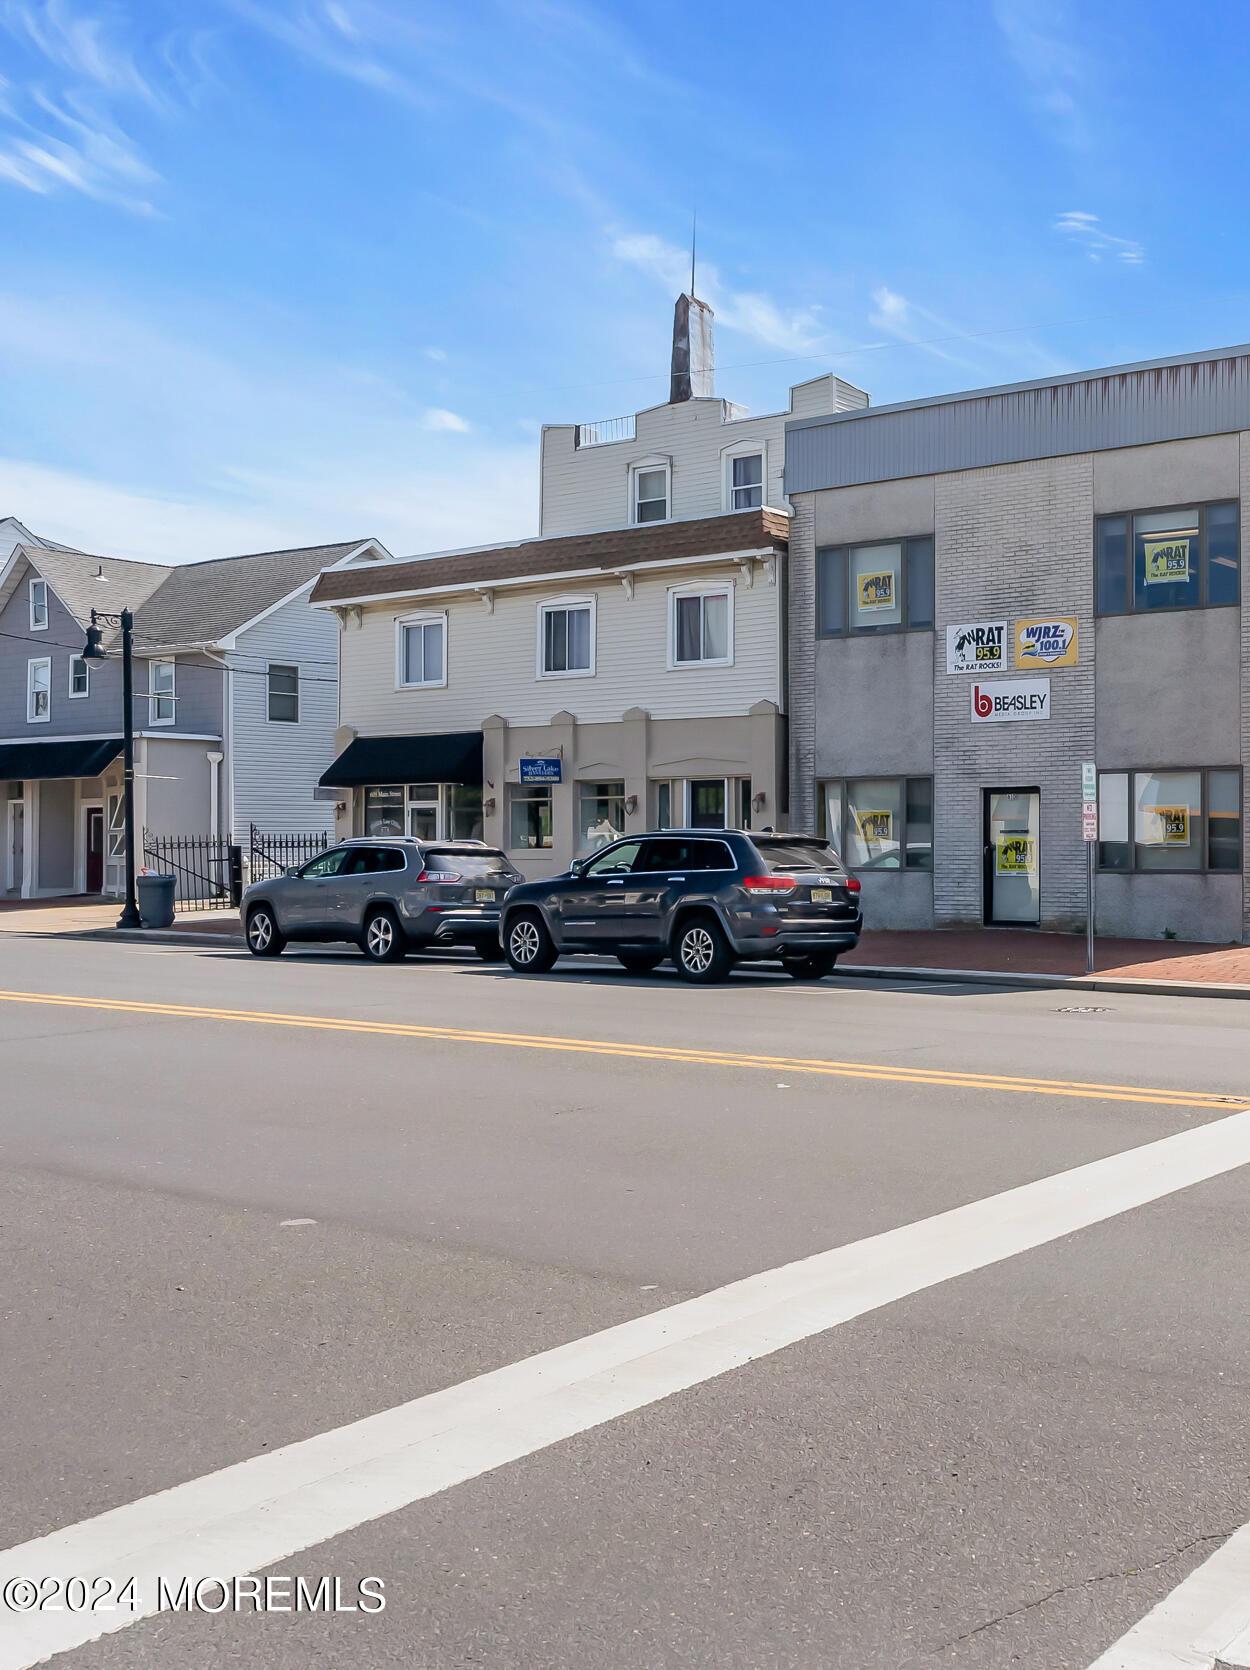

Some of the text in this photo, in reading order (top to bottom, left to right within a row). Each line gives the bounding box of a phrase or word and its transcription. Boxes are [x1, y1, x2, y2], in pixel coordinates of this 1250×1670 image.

[1167, 559, 1185, 570] 95.9
[1026, 625, 1061, 643] WJRZ
[1039, 639, 1067, 651] 100.1
[977, 648, 1000, 660] 95.9
[994, 693, 1047, 711] BEASLEY
[1166, 823, 1184, 833] 95.9
